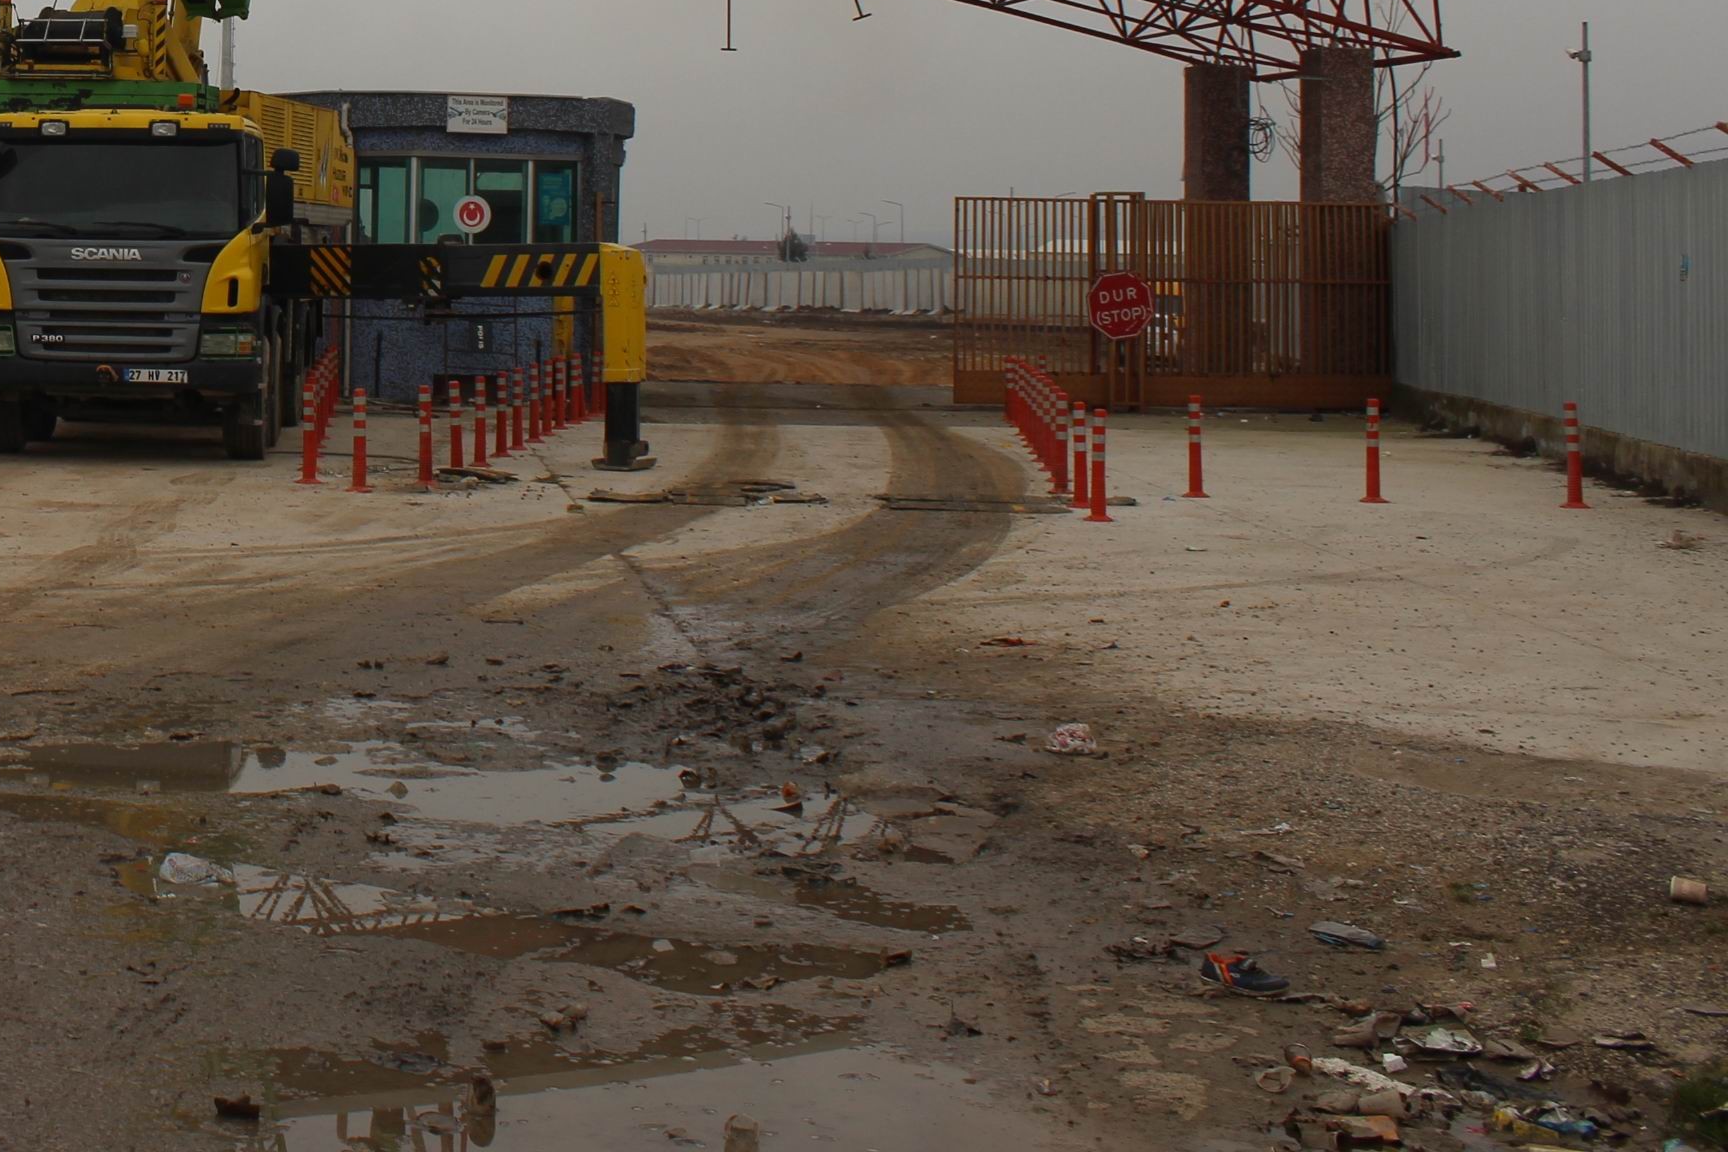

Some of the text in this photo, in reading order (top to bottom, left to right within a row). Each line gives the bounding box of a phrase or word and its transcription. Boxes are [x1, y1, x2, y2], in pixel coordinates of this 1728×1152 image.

[70, 247, 144, 261] SCANIA
[1099, 287, 1137, 304] DUR
[1096, 305, 1147, 326] (STOP)
[129, 370, 186, 381] 27 HV 217
